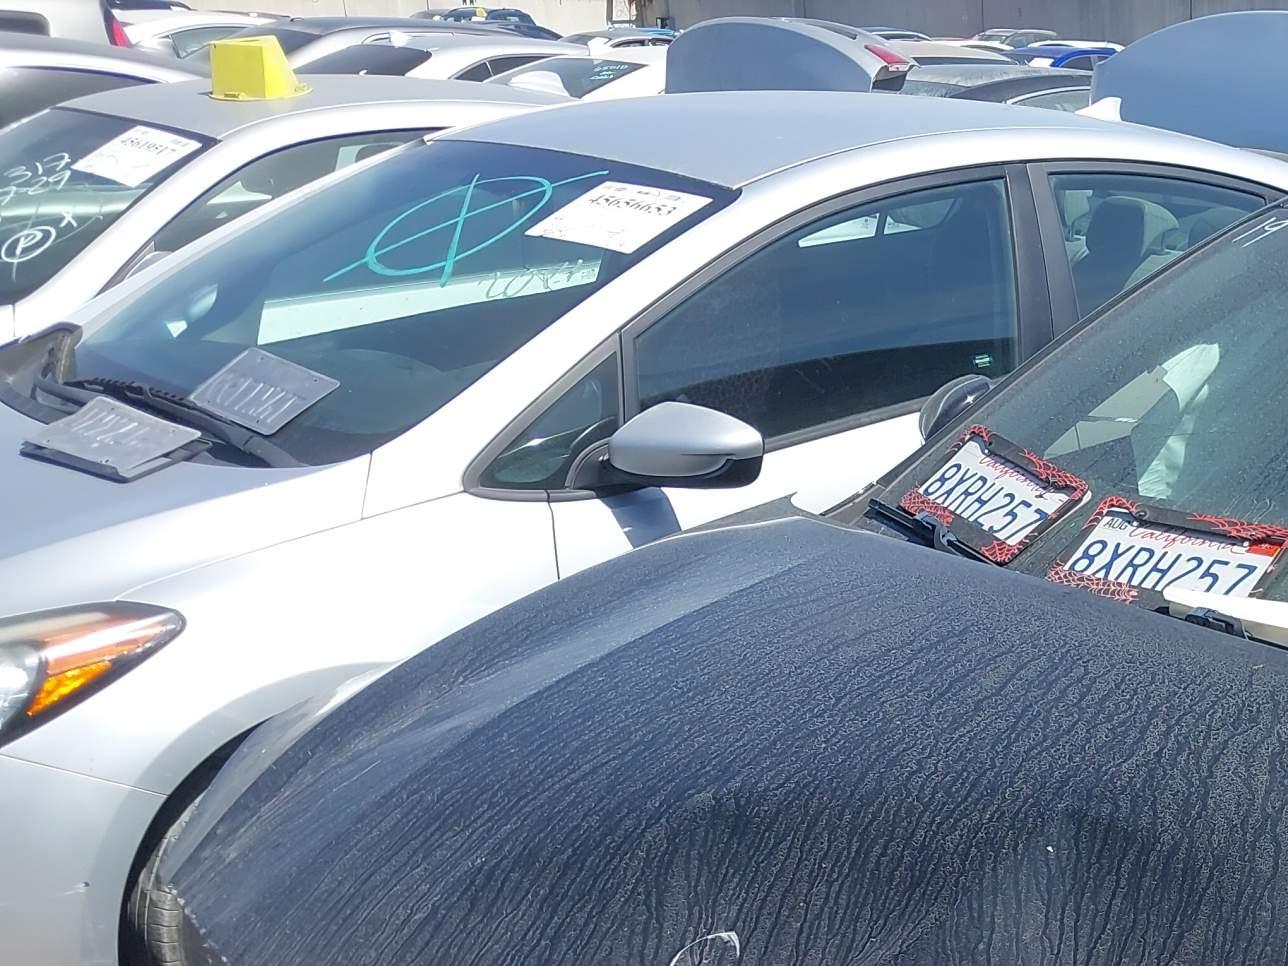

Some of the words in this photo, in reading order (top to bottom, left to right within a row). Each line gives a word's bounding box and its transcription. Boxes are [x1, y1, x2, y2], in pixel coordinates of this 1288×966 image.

[3, 153, 71, 184] 317
[923, 463, 1049, 541] 8XRH257
[1103, 517, 1129, 531] AUG
[1128, 525, 1240, 554] California
[1070, 539, 1258, 596] 8XRH257
